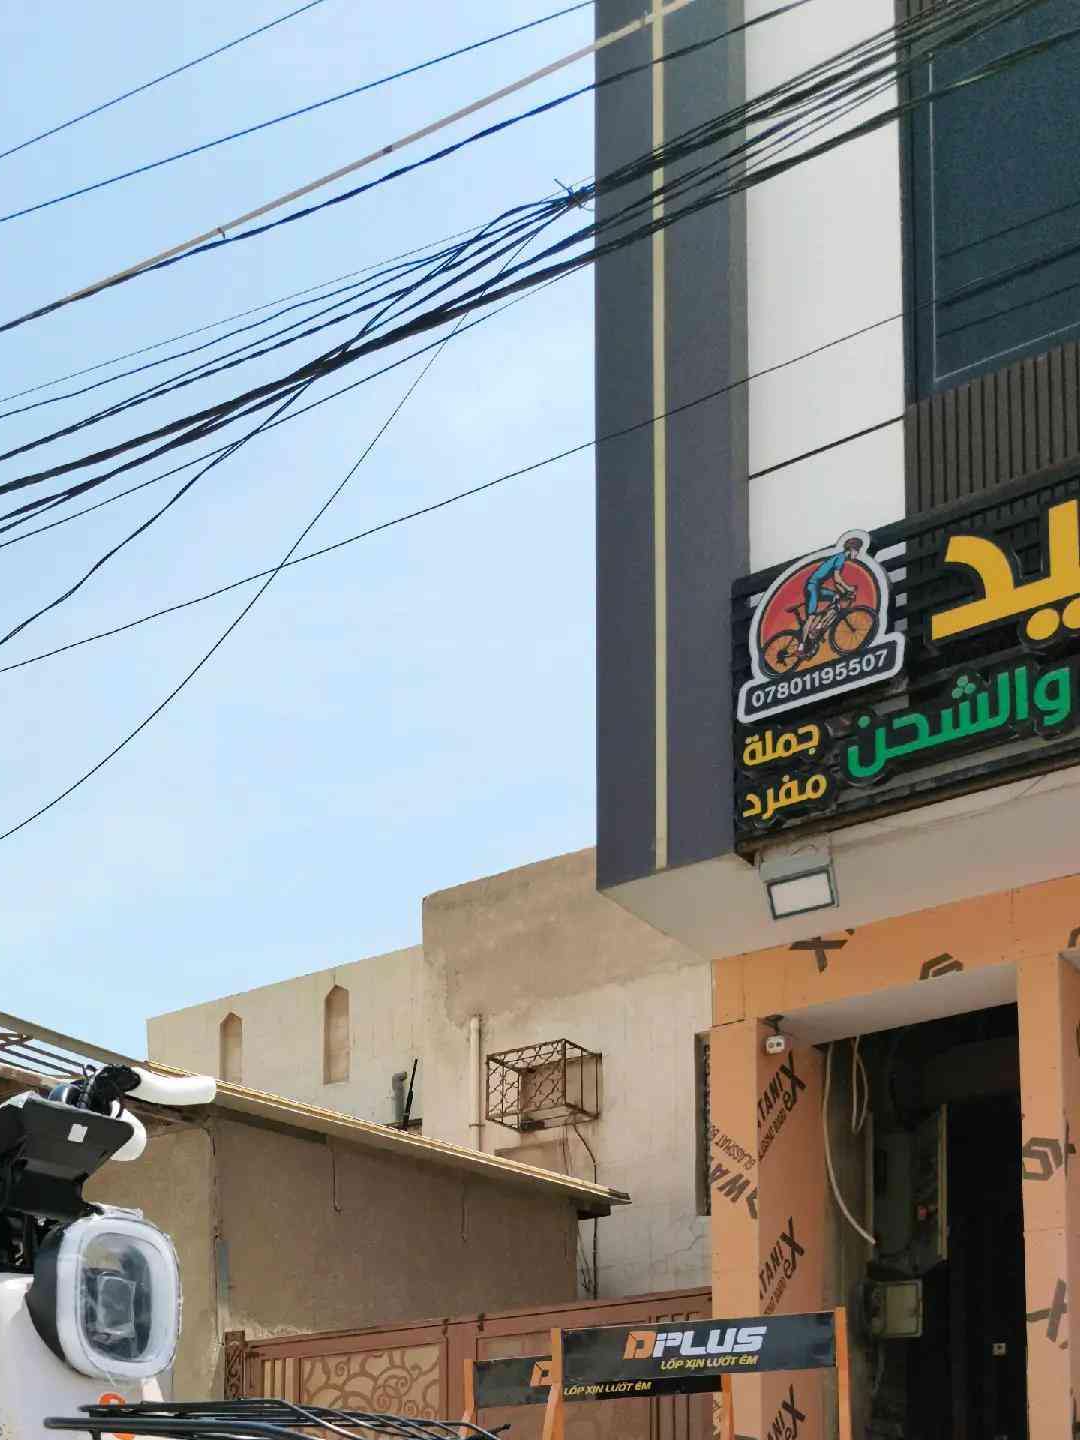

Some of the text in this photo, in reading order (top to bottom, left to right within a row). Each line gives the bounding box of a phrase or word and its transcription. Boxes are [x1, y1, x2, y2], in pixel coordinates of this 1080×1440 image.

[931, 500, 1080, 640] يد
[751, 649, 888, 708] 07801195507
[742, 724, 820, 766] جملة
[847, 665, 1070, 778] والشحن
[742, 774, 828, 820] مفرد
